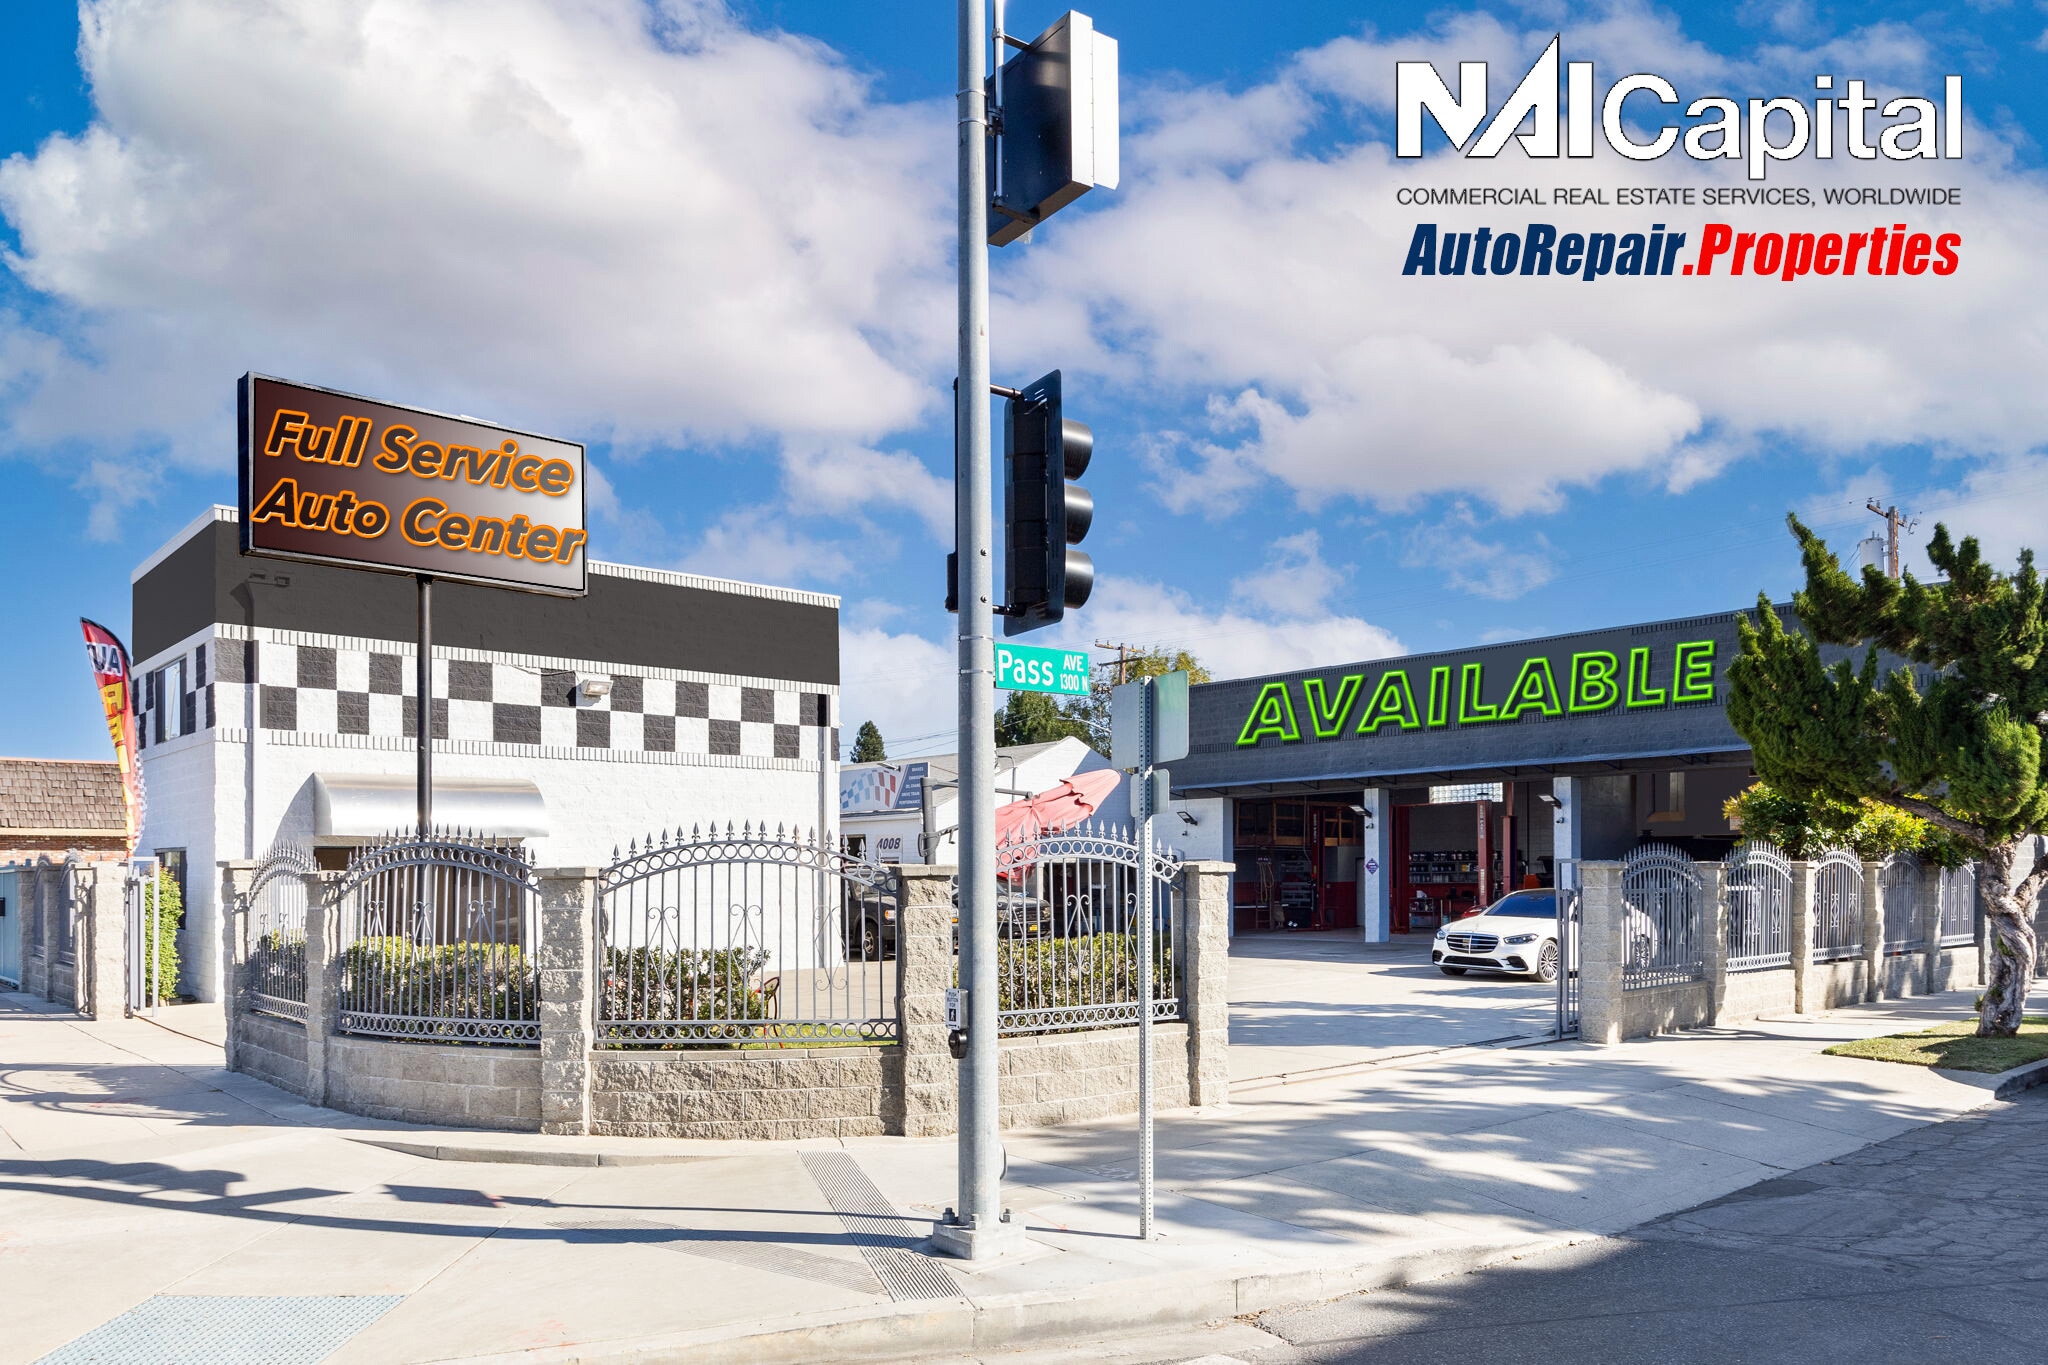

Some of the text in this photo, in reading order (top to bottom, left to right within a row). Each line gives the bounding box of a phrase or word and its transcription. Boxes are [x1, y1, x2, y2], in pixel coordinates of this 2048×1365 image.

[265, 409, 574, 497] Full Service
[252, 477, 588, 565] Auto Center
[997, 649, 1084, 686] Pass AVE
[1060, 673, 1088, 692] 1300 N
[1235, 640, 1716, 746] AVAILABLE
[877, 837, 901, 850] 4008
